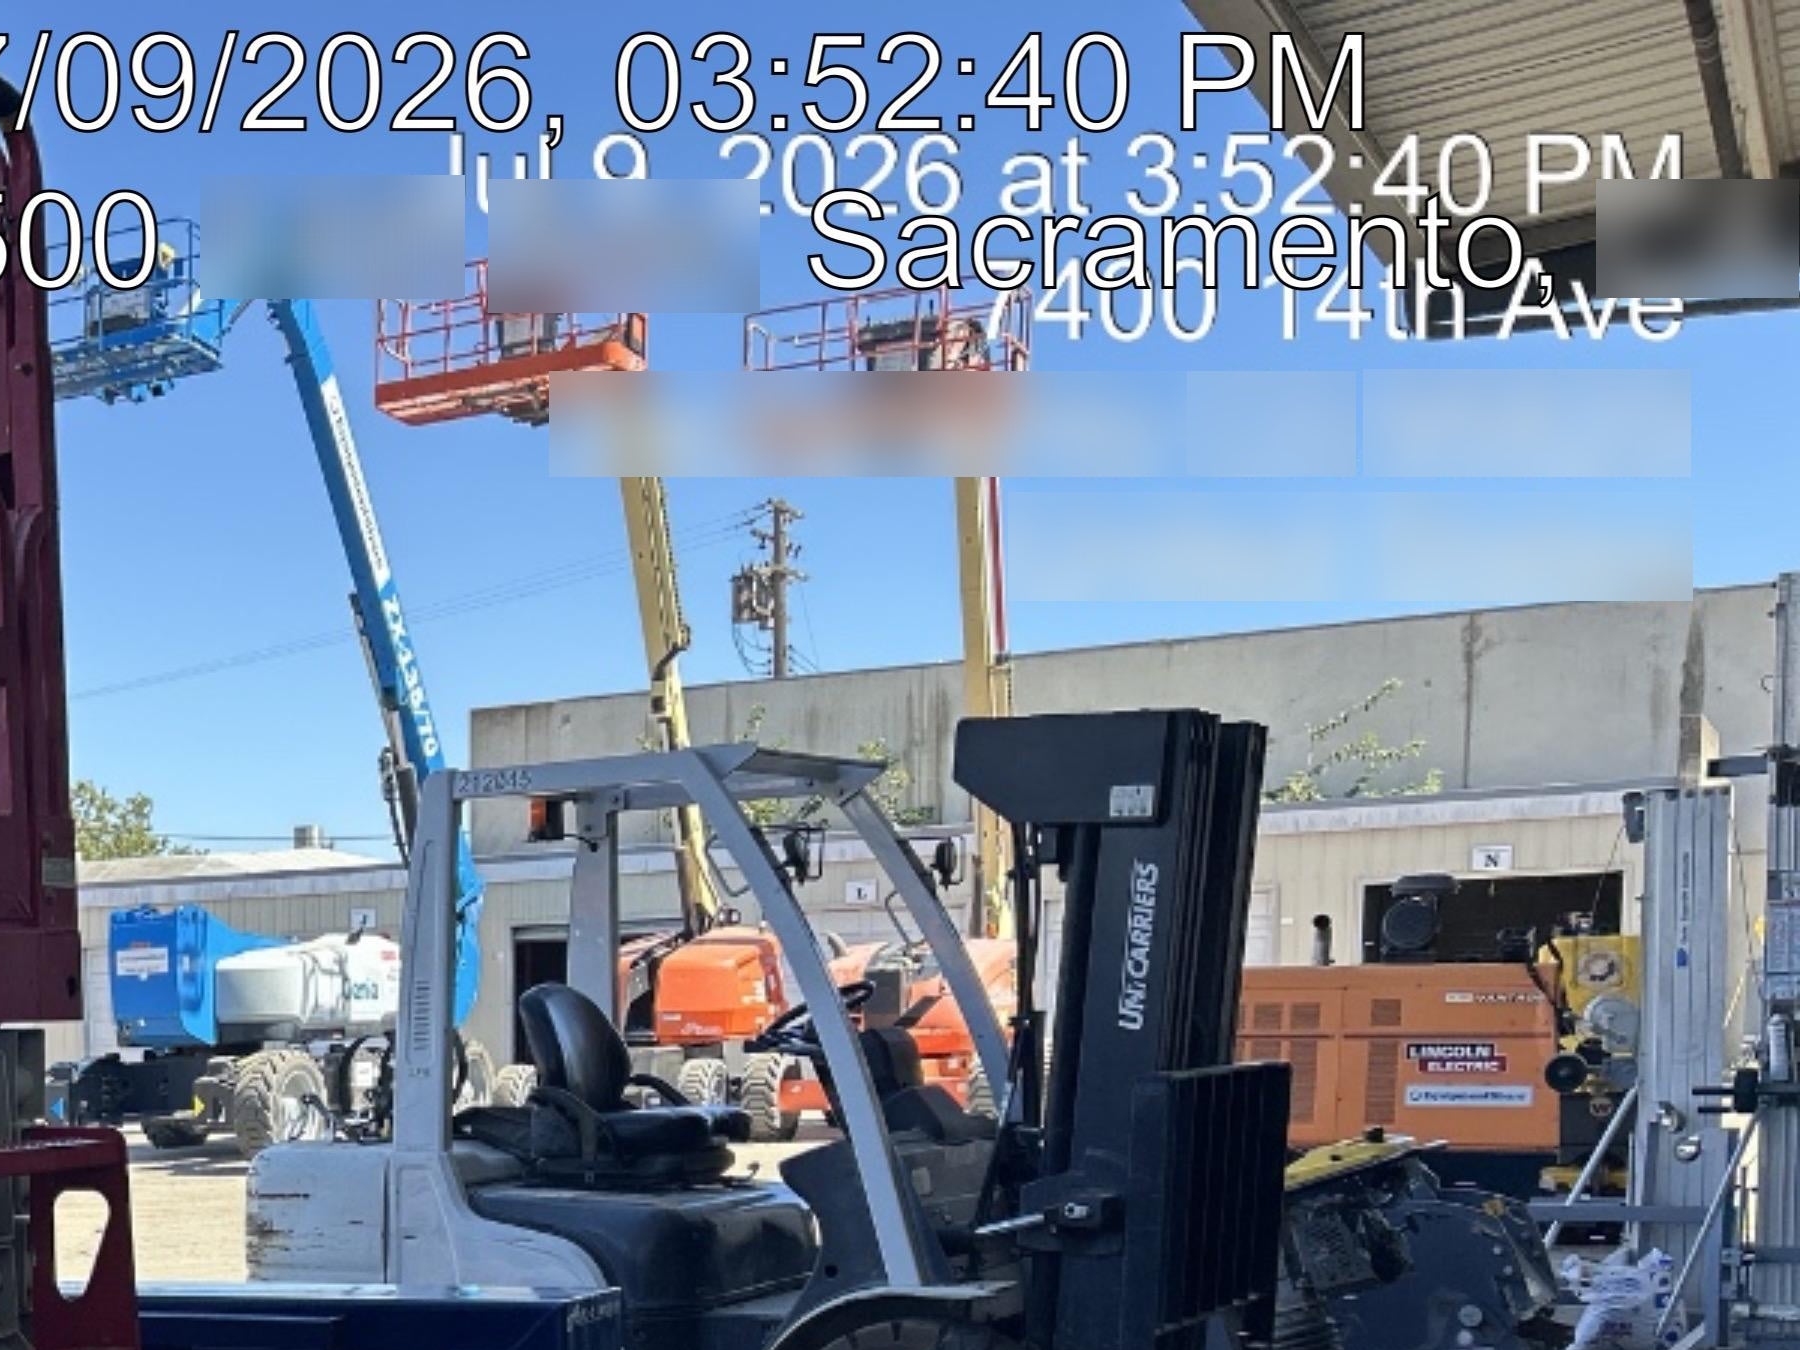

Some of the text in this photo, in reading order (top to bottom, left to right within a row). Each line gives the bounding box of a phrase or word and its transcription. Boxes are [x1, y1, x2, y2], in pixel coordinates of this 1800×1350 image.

[1484, 854, 1499, 868] N
[1408, 1044, 1492, 1059] LINCOLN
[1426, 1060, 1499, 1073] ELECTRIC
